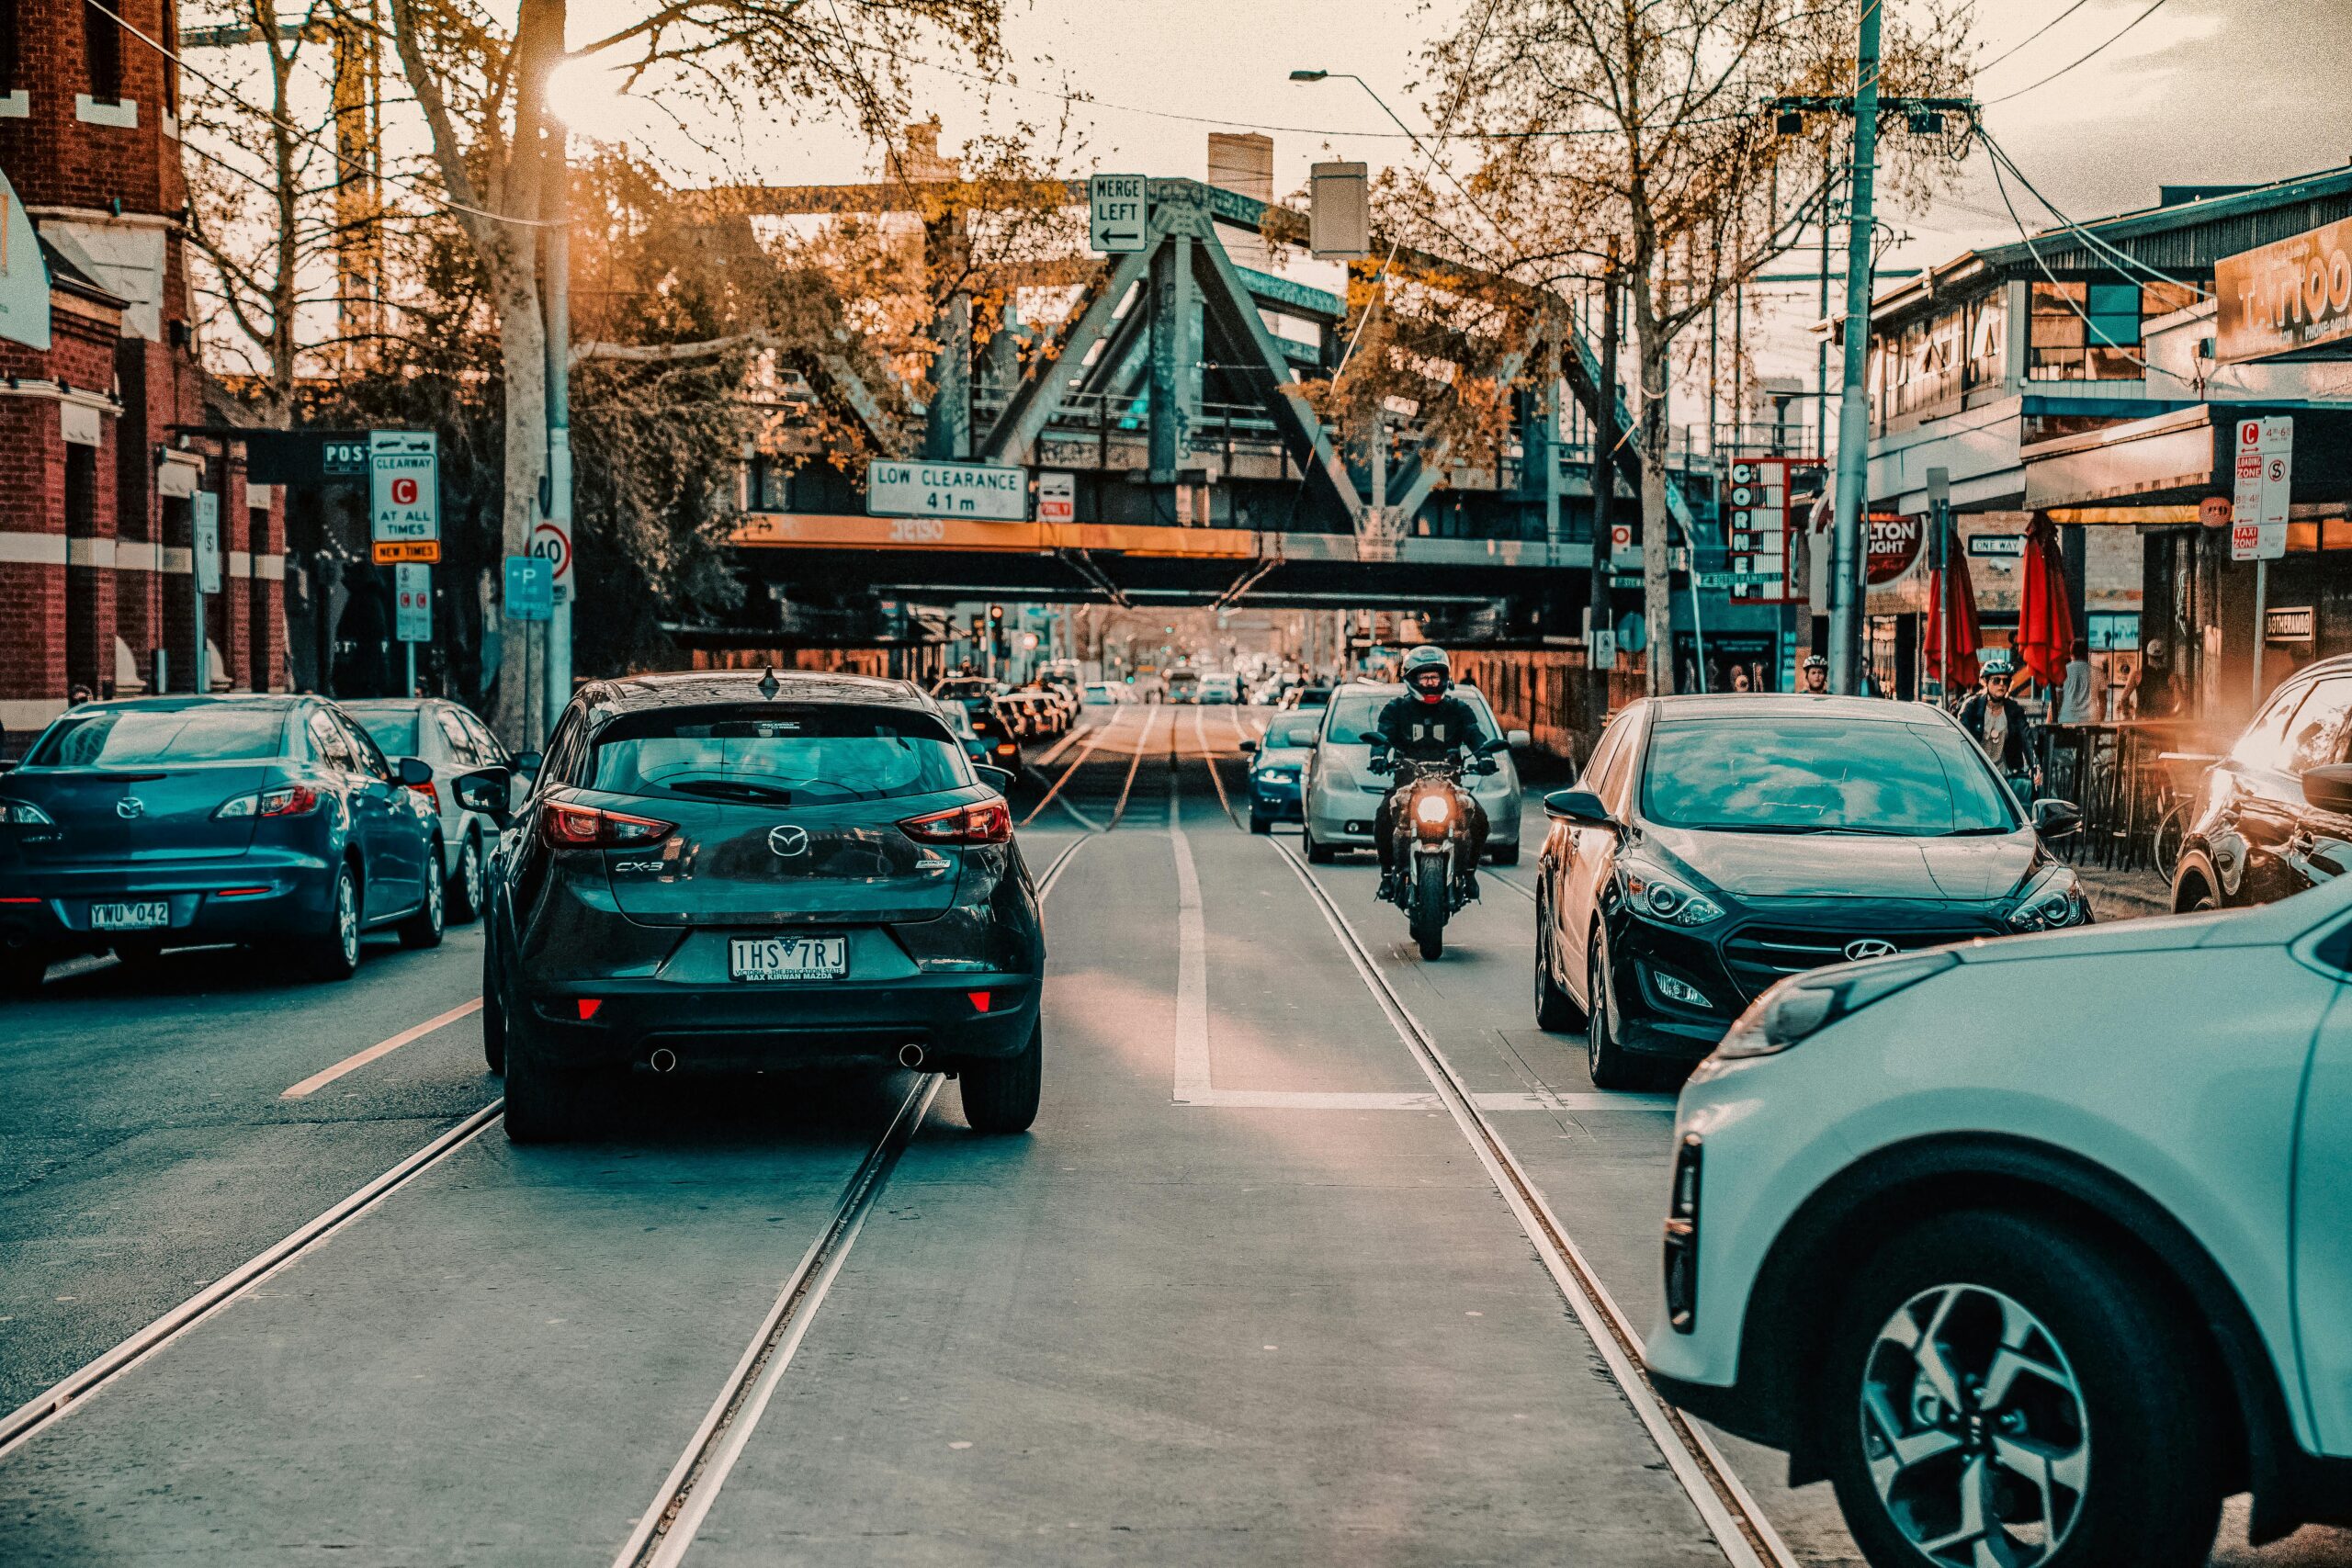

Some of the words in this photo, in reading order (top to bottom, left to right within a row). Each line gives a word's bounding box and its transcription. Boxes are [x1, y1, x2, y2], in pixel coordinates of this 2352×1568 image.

[1097, 180, 1139, 197] MERGE
[1099, 203, 1137, 220] LEFT
[2246, 423, 2255, 443] C
[326, 446, 371, 461] POS
[377, 459, 431, 469] CLEARWAY
[2238, 457, 2261, 468] LOADING
[878, 468, 910, 484] LOW
[922, 469, 1016, 491] CLEARANCE
[2237, 468, 2261, 479] ZONE
[397, 480, 413, 503] C
[380, 511, 397, 521] AT
[405, 511, 431, 522] ALL
[387, 524, 425, 535] TIMES
[1860, 522, 1915, 540] LTON
[2237, 526, 2256, 537] TAXI
[1976, 540, 1995, 551] ONE
[1999, 539, 2018, 551] WAY
[2233, 538, 2257, 548] ZONE
[379, 547, 400, 557] NEW
[405, 545, 434, 557] TIMES
[534, 539, 561, 564] 40
[523, 569, 537, 584] P
[2267, 613, 2310, 634] BOTHERAMBO
[615, 862, 665, 873] CX-3
[93, 905, 124, 923] YWU
[136, 903, 166, 921] 042
[738, 944, 779, 969] 1HS
[798, 942, 843, 968] 7RJ
